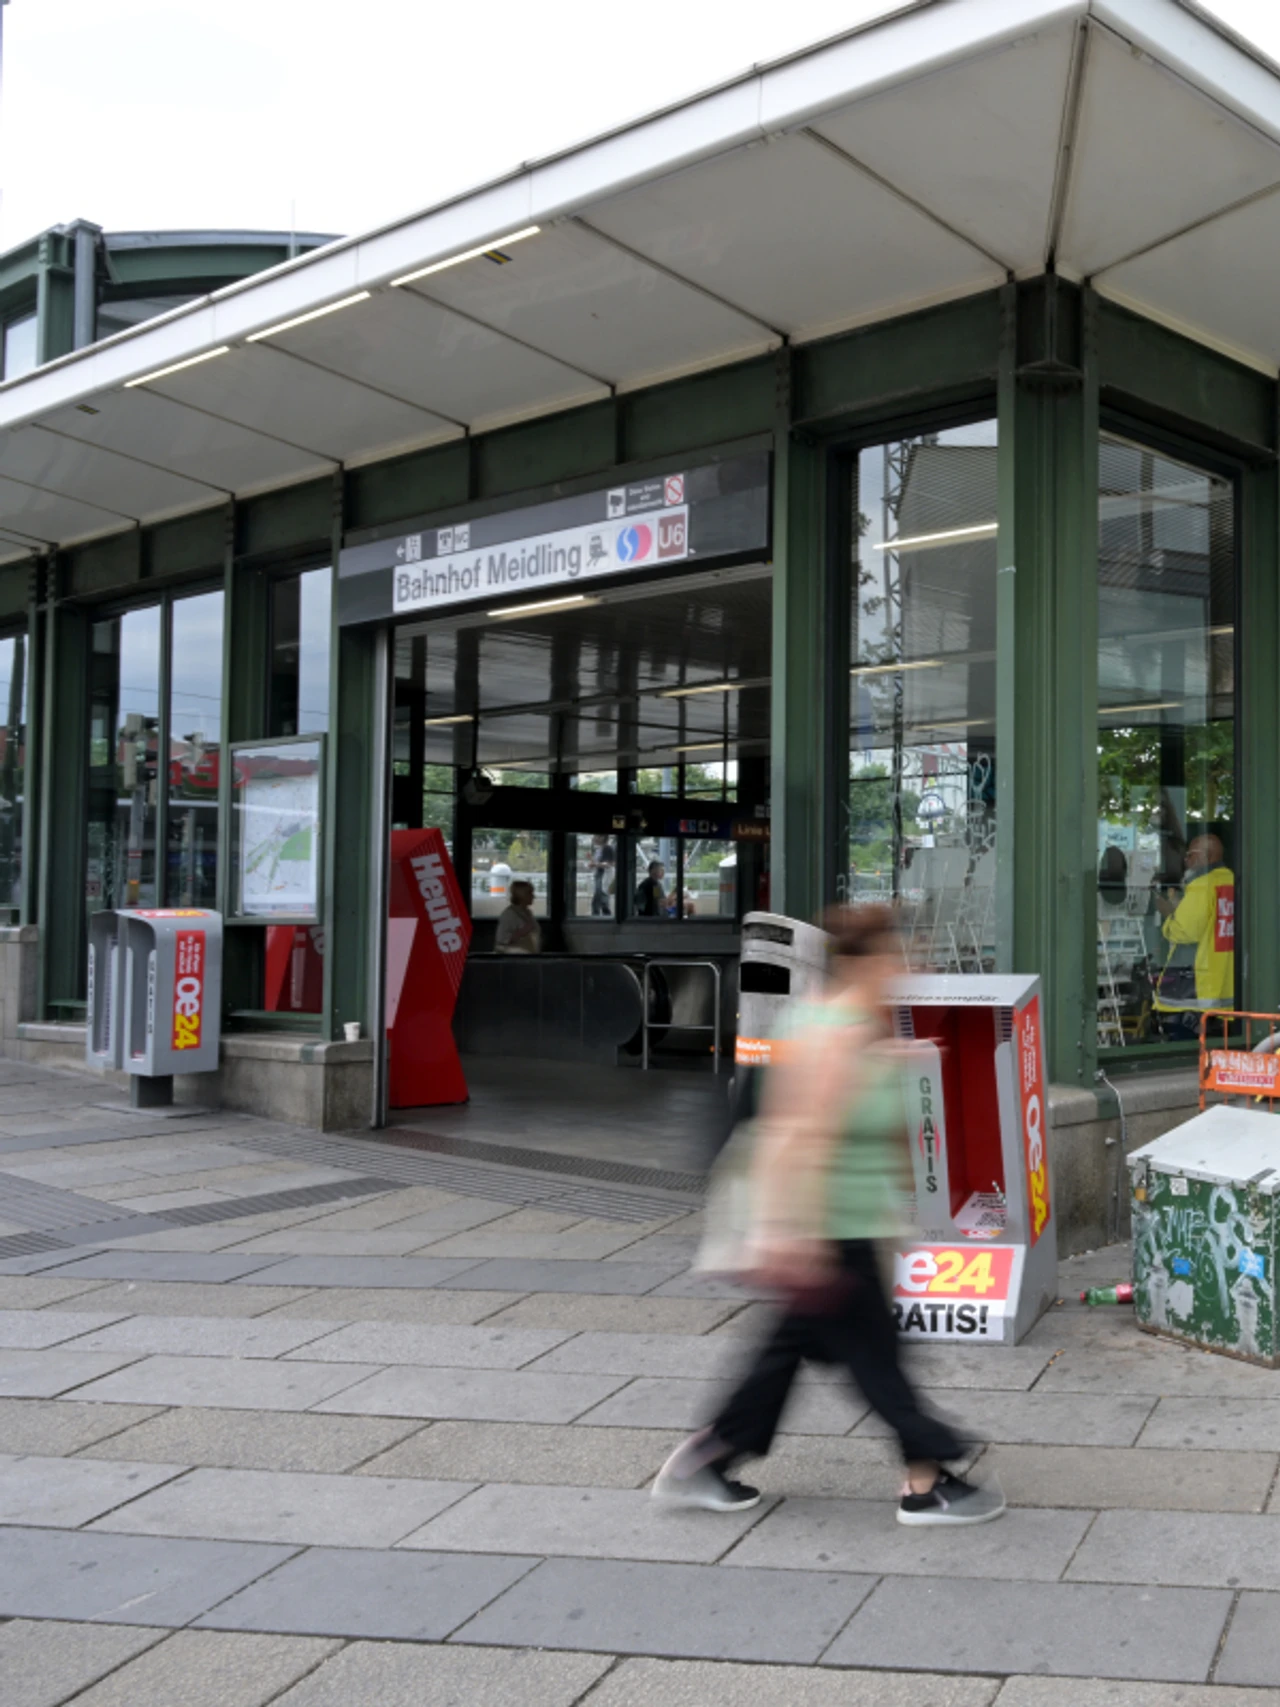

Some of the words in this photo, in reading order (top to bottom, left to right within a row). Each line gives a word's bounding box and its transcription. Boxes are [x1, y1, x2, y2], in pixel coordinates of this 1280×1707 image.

[396, 558, 482, 603] Bahnhof
[486, 543, 582, 586] Meidling
[660, 523, 684, 549] U6
[738, 823, 763, 836] Linie
[409, 852, 463, 954] Heute
[918, 1076, 938, 1193] GRATIS
[894, 1250, 996, 1294] e24
